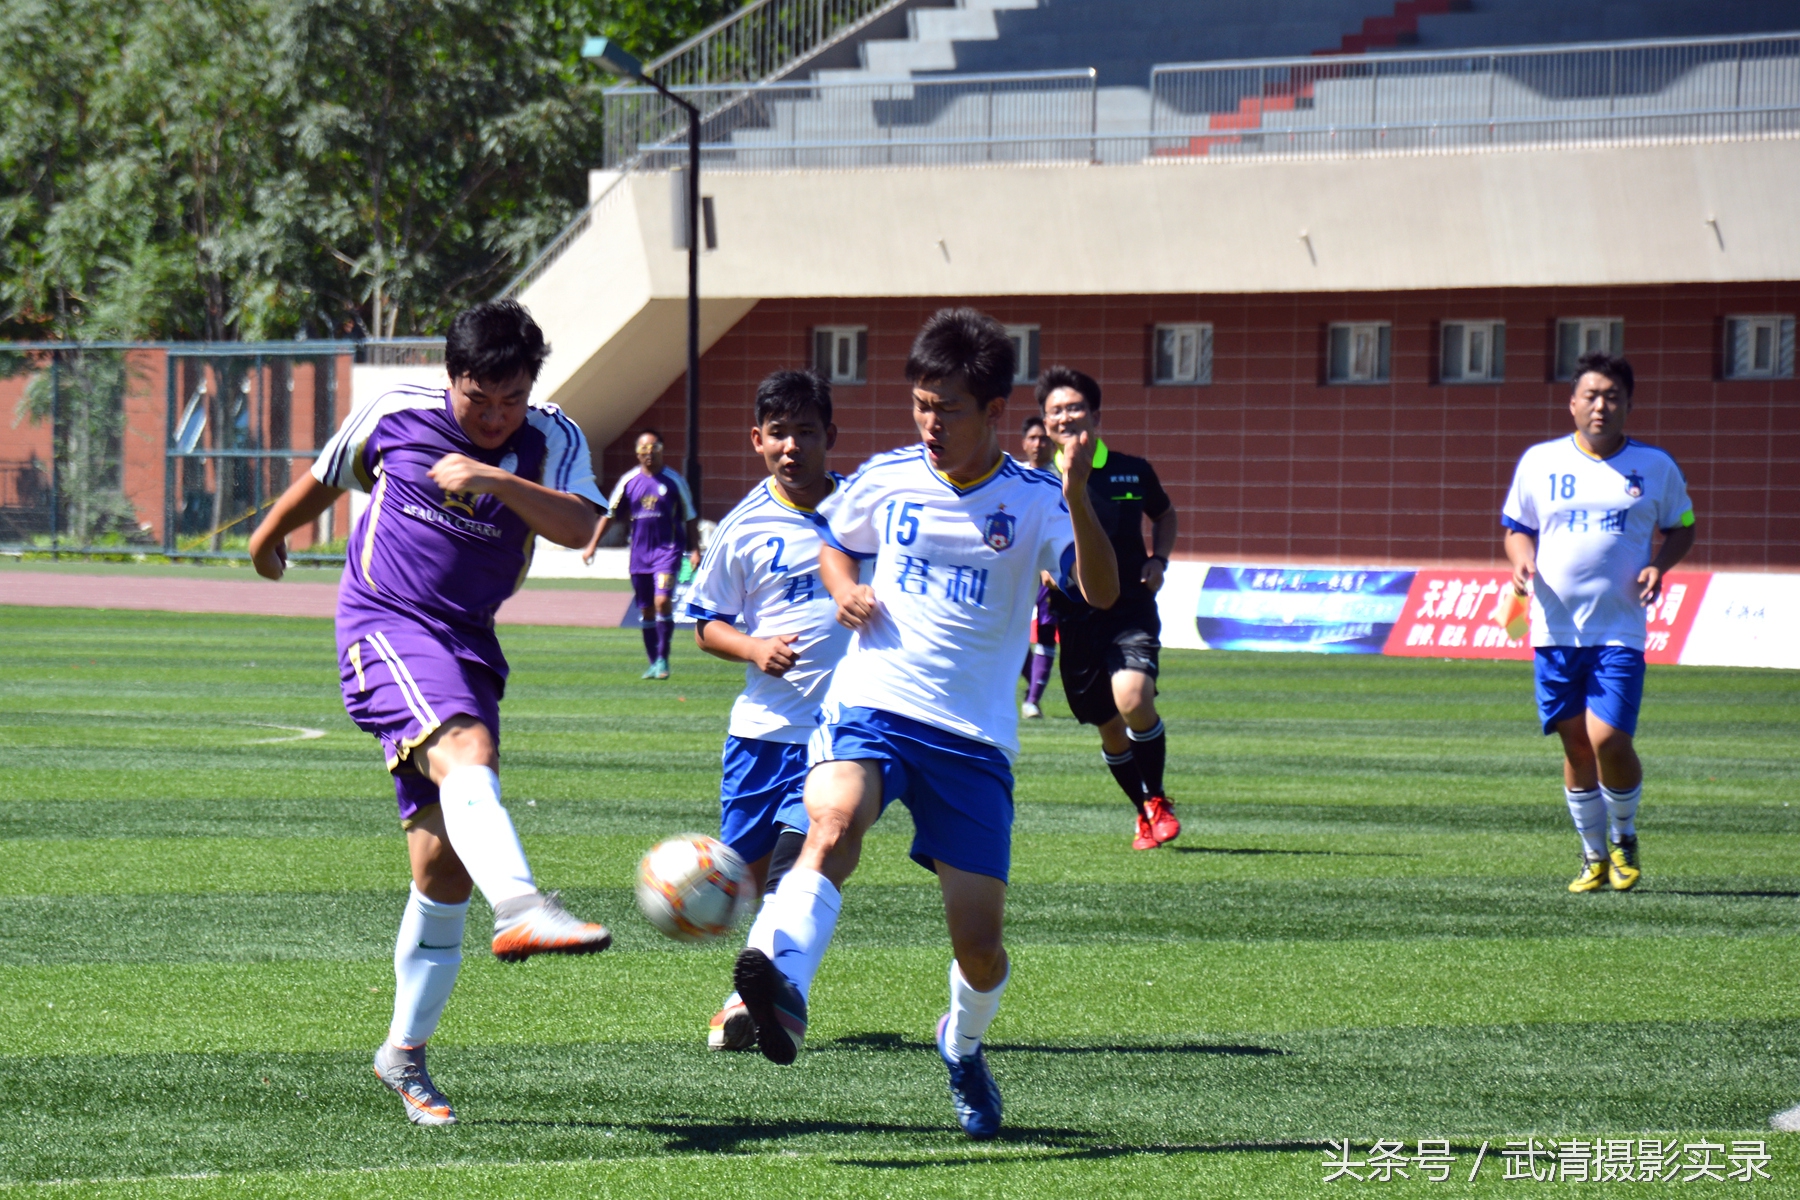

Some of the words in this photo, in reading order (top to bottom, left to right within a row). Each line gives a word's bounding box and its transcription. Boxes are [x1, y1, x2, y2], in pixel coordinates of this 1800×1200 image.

[1549, 473, 1576, 501] 18
[455, 518, 502, 539] CHARM
[885, 499, 924, 546] 15
[766, 536, 789, 573] 2
[894, 554, 989, 608] 君利
